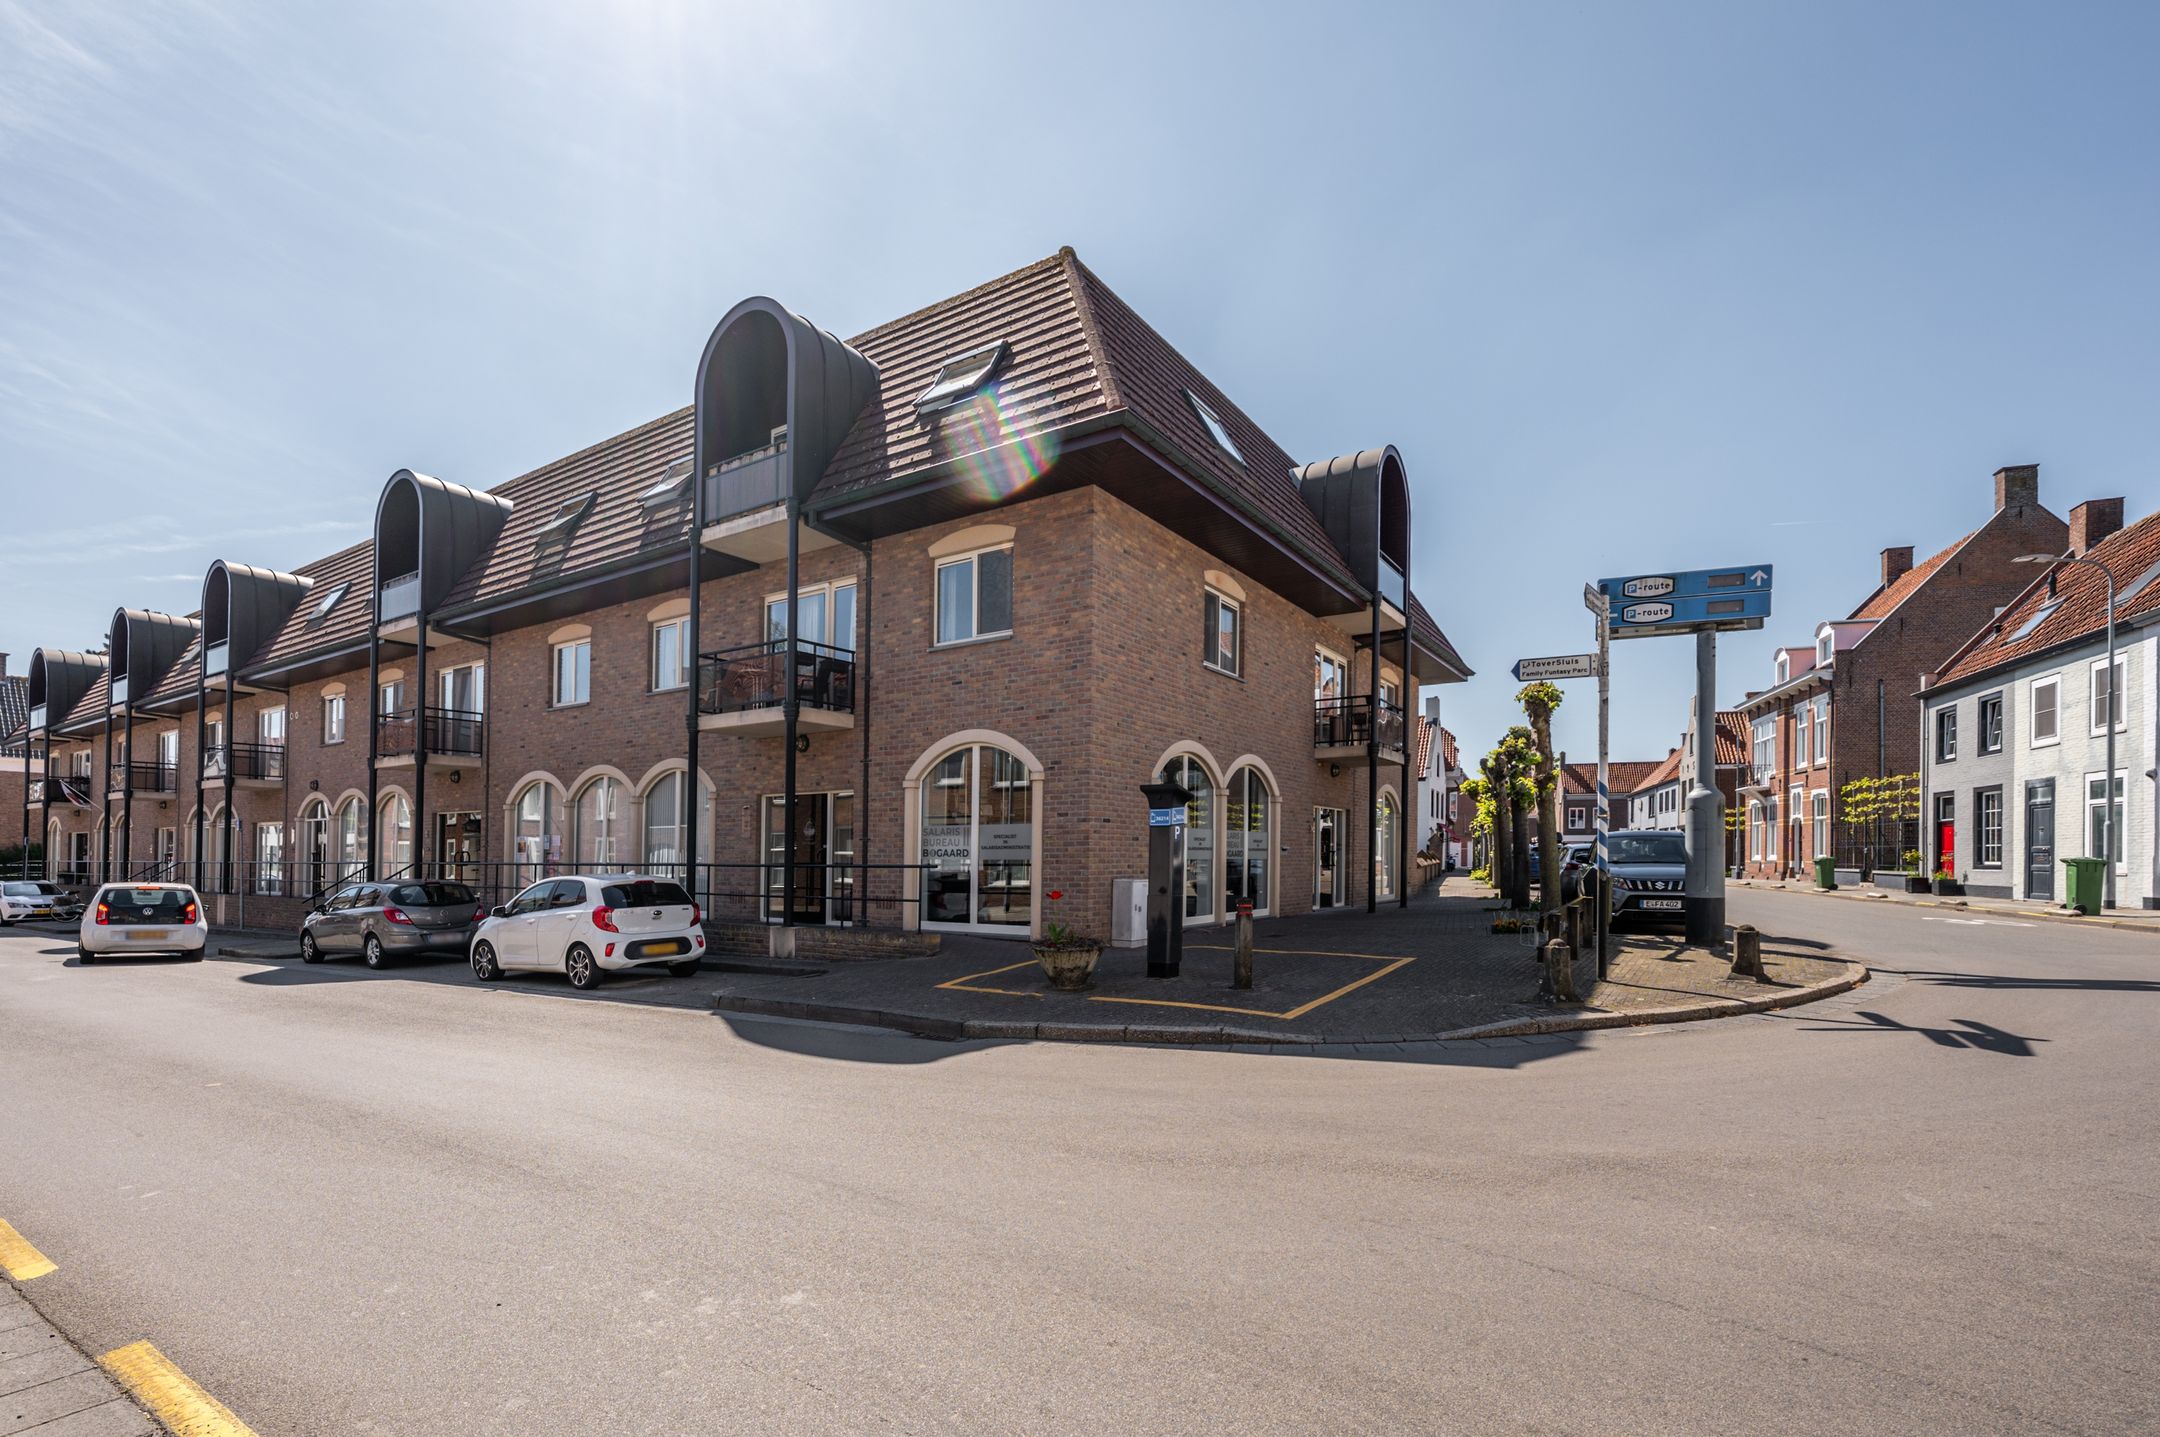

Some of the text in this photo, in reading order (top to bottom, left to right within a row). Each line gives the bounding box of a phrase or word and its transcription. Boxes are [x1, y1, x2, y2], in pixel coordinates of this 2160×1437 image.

[922, 827, 960, 837] SALARIS
[1175, 825, 1180, 839] P
[923, 838, 960, 847] BUREAU
[922, 848, 969, 858] BOGAARD
